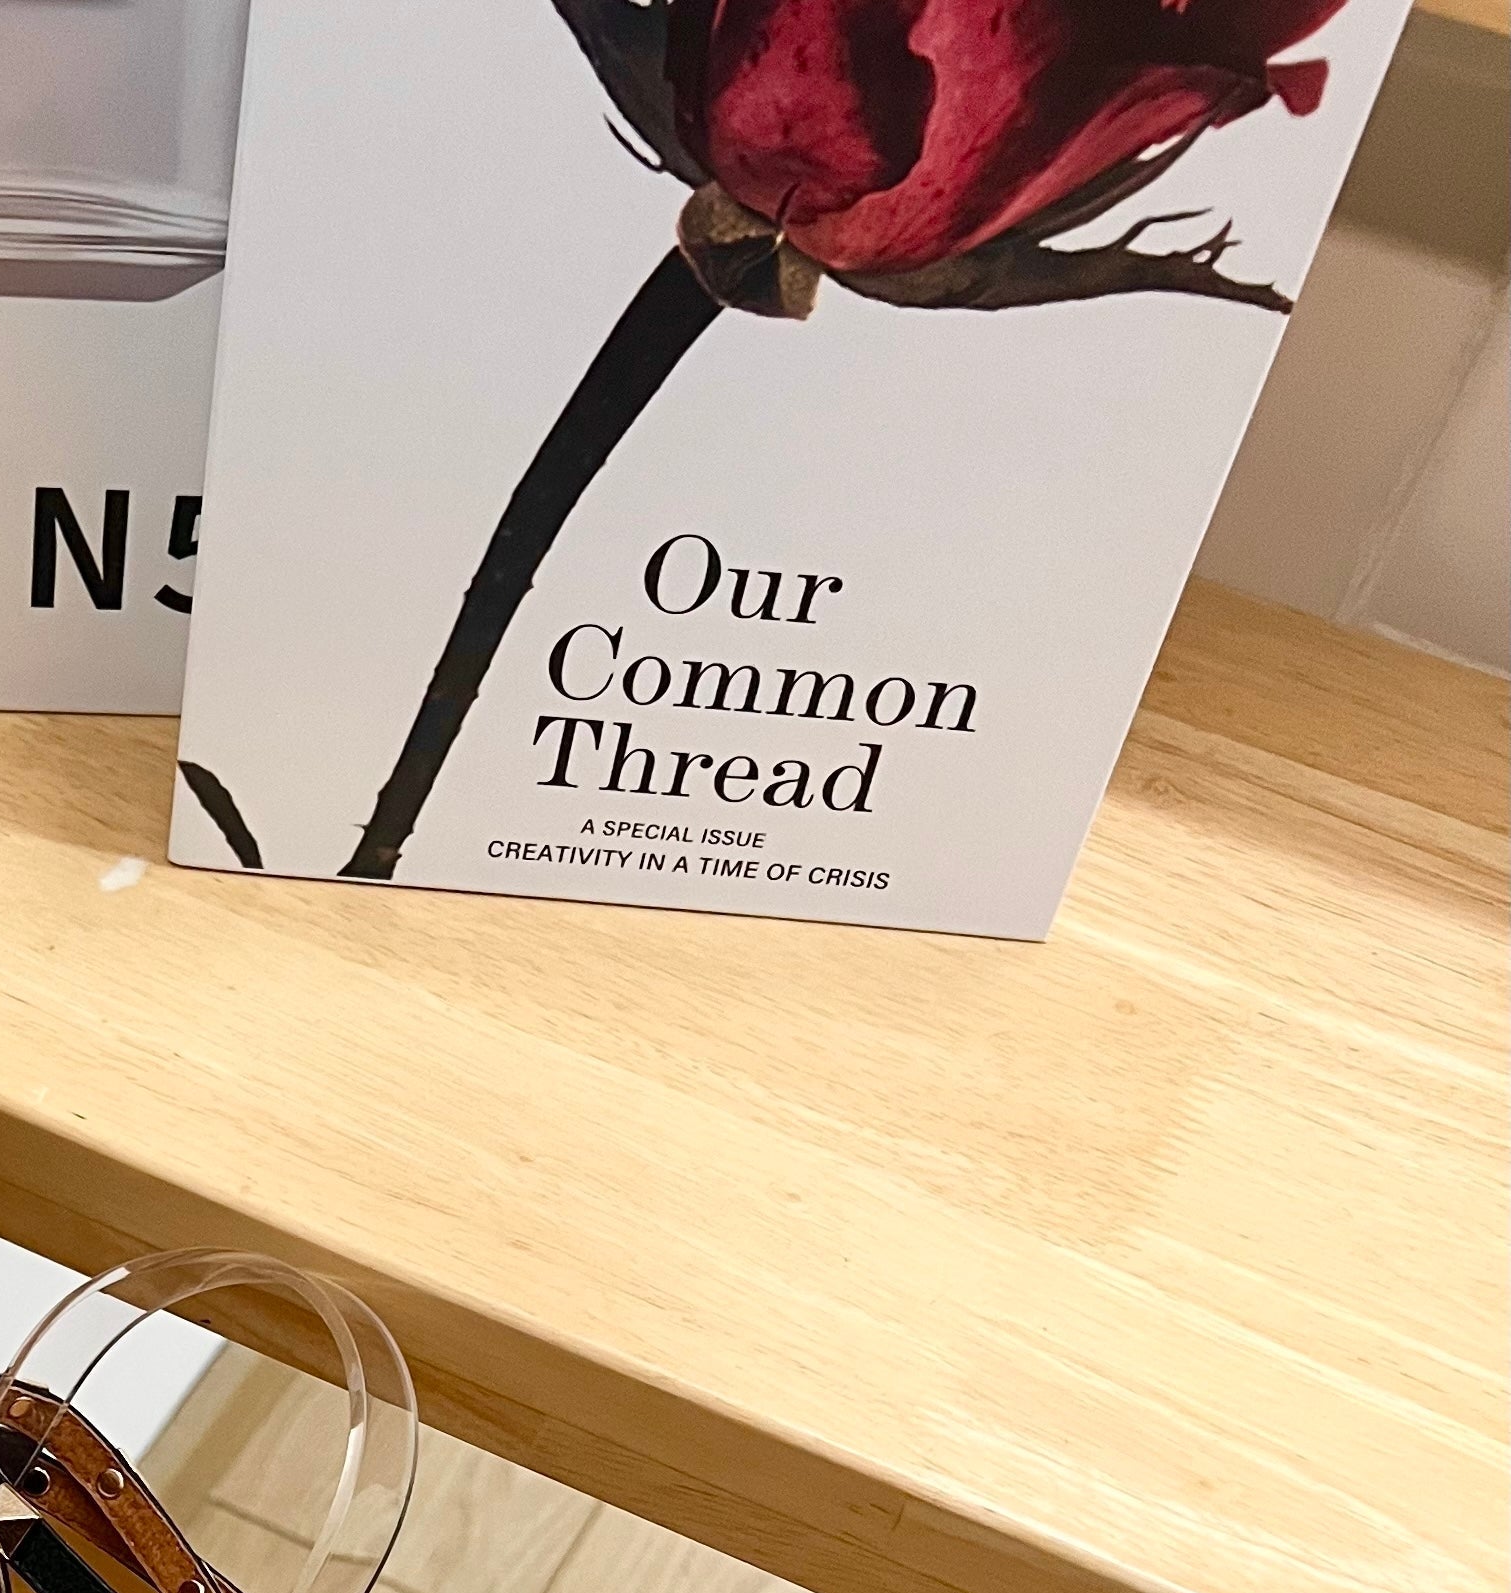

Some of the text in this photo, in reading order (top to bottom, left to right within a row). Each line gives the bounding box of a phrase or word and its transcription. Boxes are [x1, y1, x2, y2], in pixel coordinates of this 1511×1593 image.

[643, 533, 844, 626] Our
[547, 623, 978, 734] Common
[532, 714, 884, 814] Thread
[486, 840, 891, 891] CREATIVITY IN A TIME OF CRISIS
[579, 818, 767, 850] A SPECIAL ISSUE
